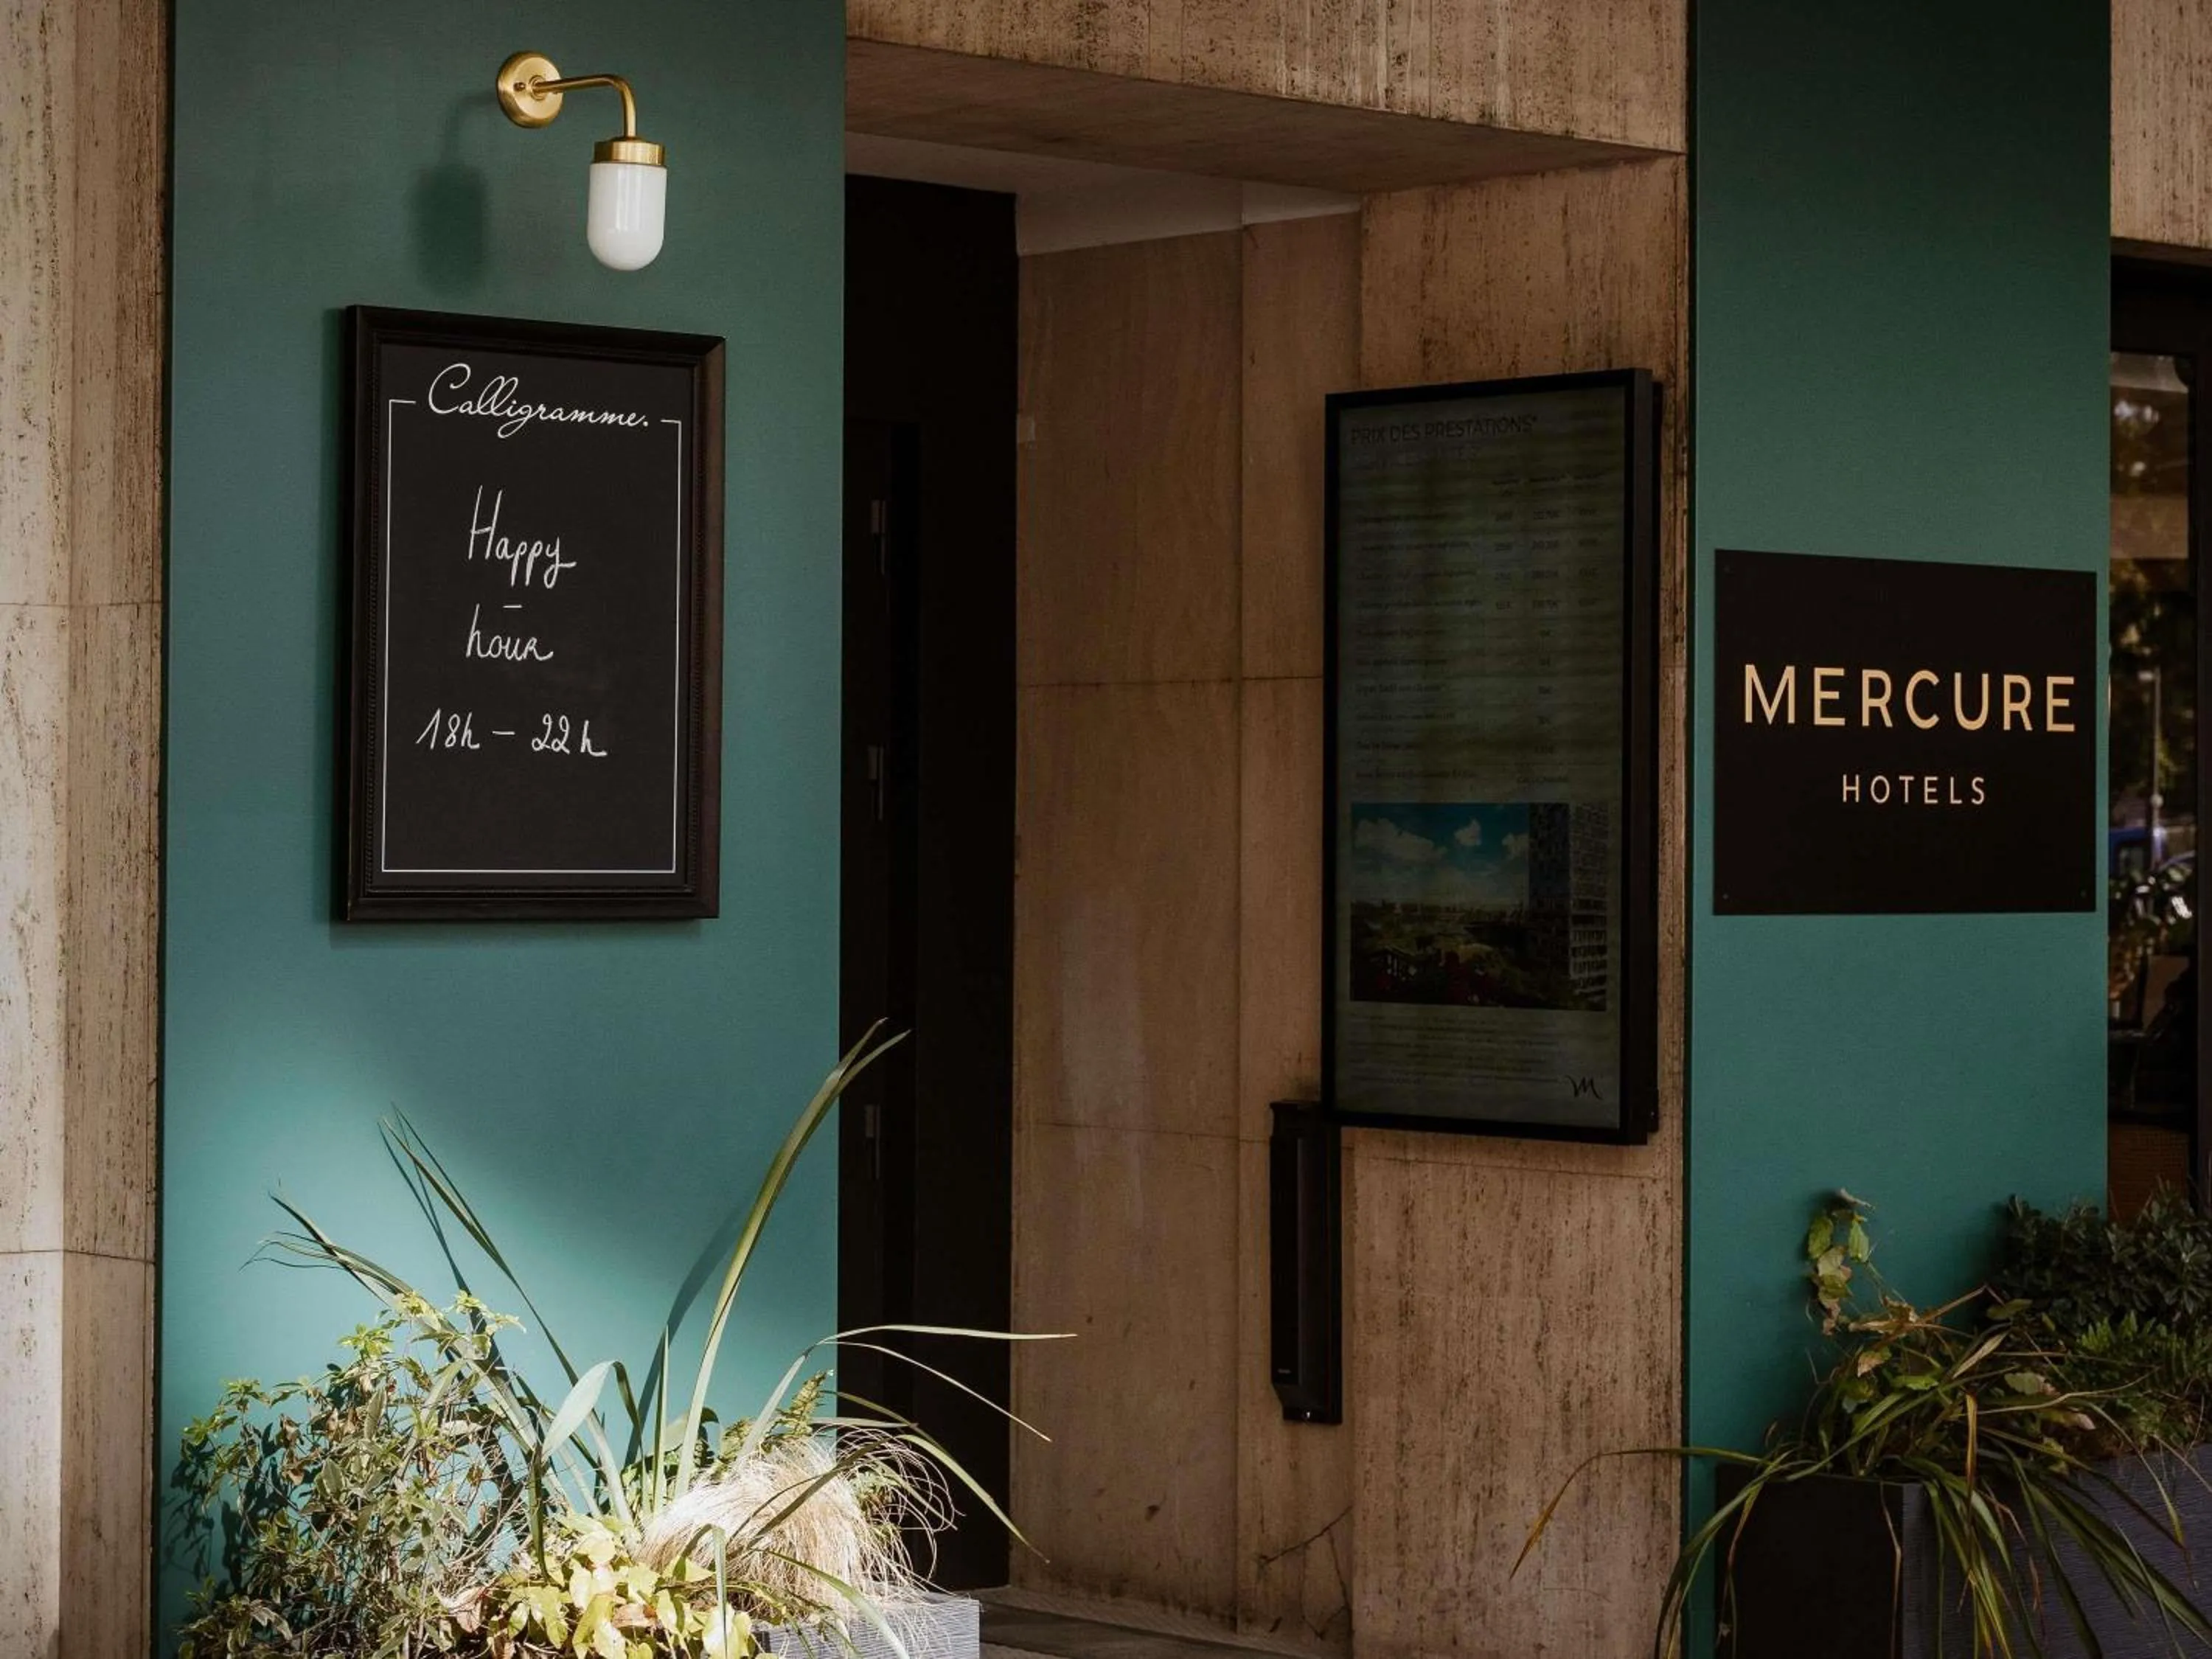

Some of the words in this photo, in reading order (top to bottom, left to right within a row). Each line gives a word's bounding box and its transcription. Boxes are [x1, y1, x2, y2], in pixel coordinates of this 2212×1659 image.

[428, 363, 649, 439] Calligramme.
[1350, 428, 1385, 445] PRIX
[1389, 424, 1420, 442] DES
[468, 485, 577, 589] Happy
[465, 603, 554, 662] hour
[1745, 664, 2075, 732] MERCURE
[415, 708, 481, 750] 18h
[531, 713, 608, 757] 22h
[1843, 774, 1985, 805] HOTELS
